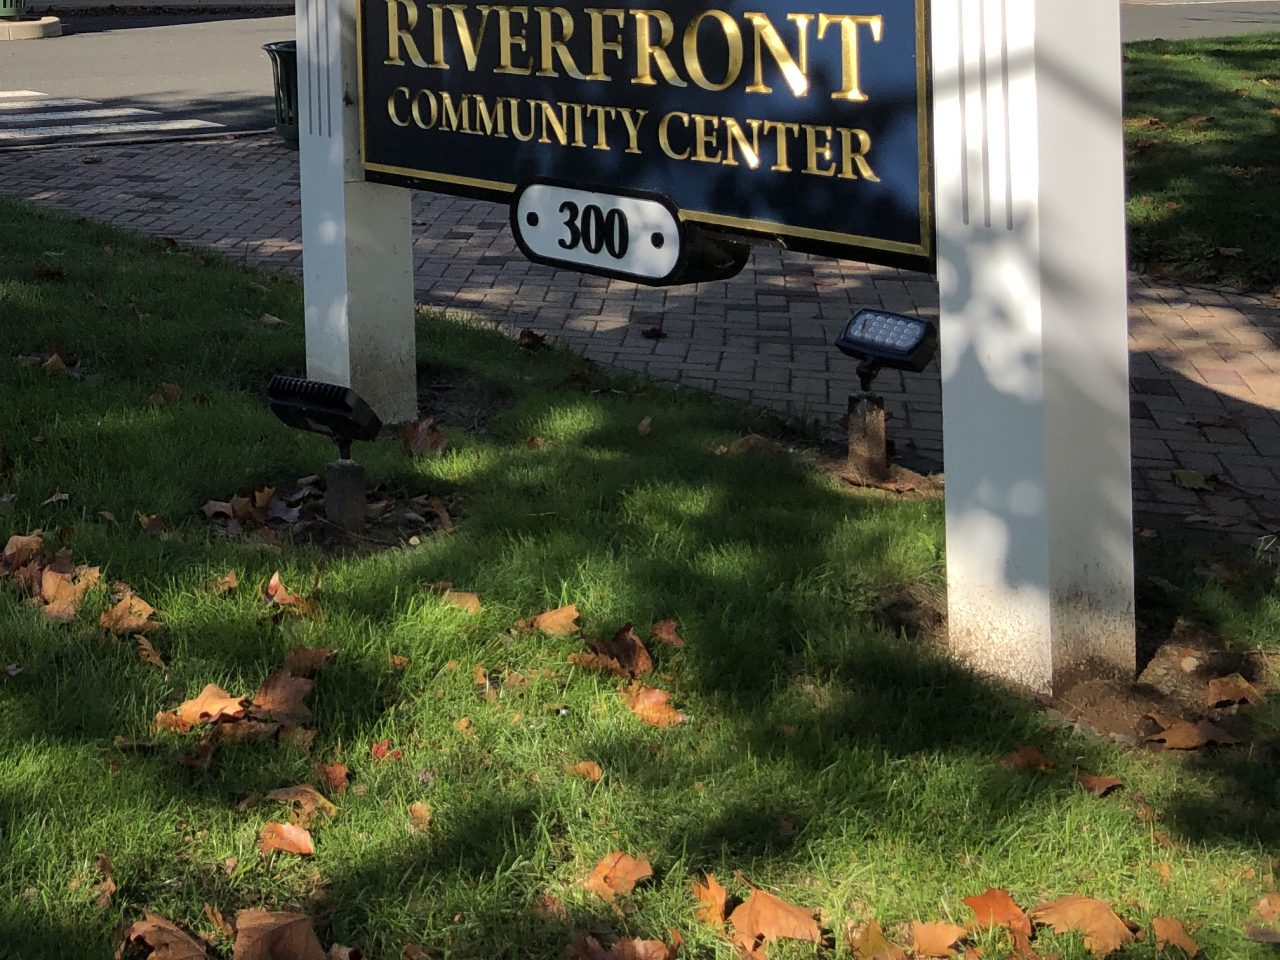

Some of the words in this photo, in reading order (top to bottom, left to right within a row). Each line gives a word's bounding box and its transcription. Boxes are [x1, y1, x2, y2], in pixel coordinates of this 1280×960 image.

[387, 86, 650, 155] COMMUNITY
[658, 111, 881, 183] CENTER
[557, 200, 630, 259] 300
